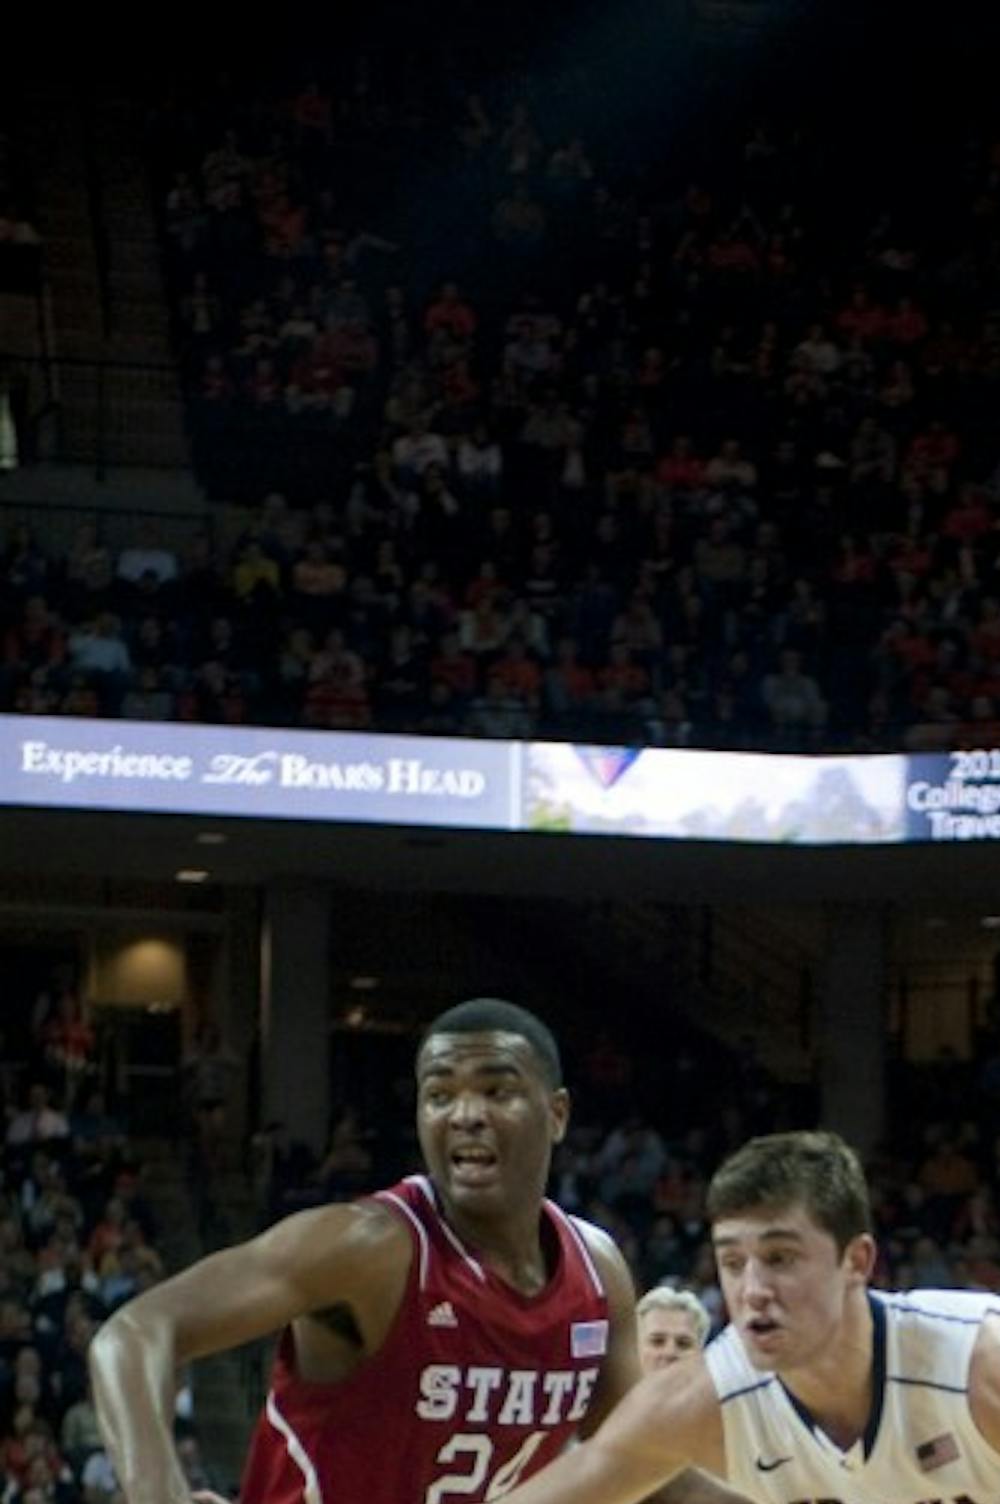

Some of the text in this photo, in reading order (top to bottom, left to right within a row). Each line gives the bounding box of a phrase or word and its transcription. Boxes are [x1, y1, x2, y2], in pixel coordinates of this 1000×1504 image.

[22, 741, 193, 783] Experience
[203, 751, 278, 786] The
[387, 757, 486, 797] HEAD
[416, 1363, 600, 1425] STATE
